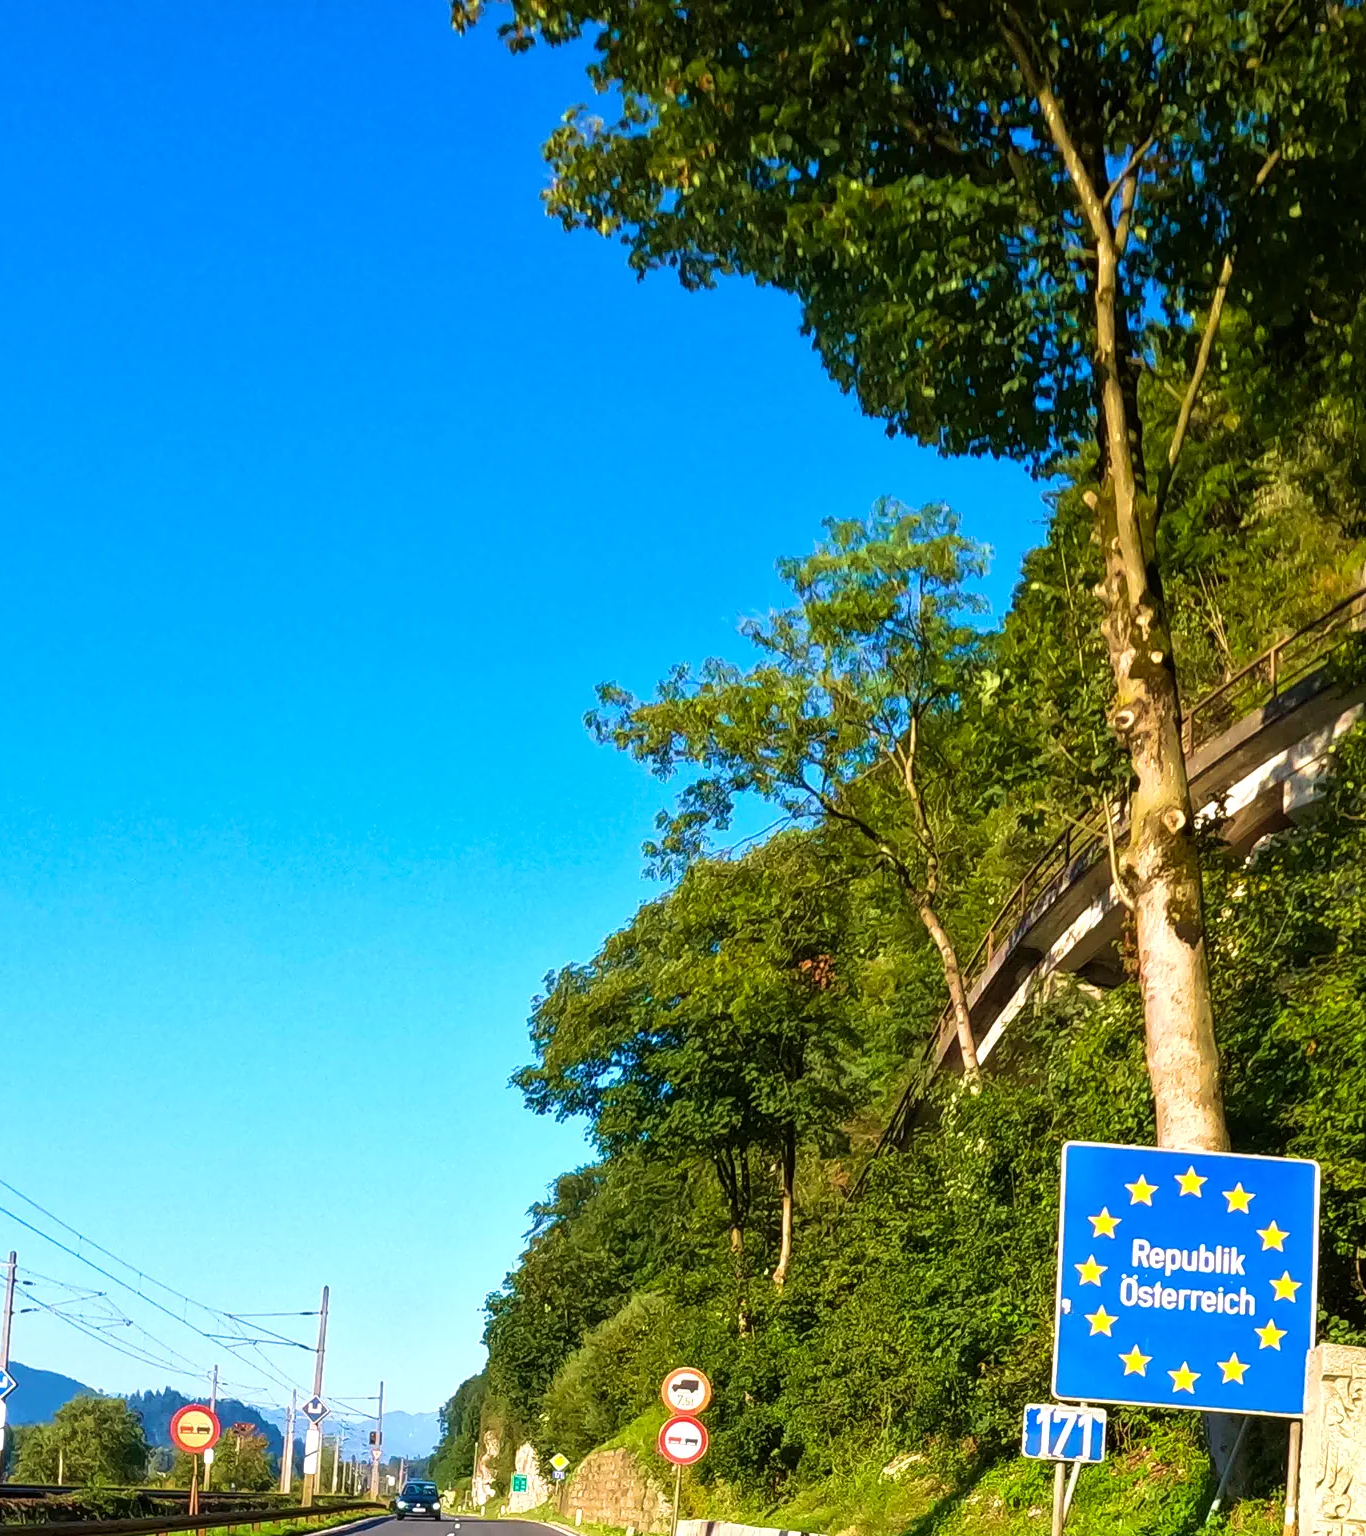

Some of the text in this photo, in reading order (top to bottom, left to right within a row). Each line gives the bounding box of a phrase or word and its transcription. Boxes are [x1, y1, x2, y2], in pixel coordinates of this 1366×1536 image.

[1131, 1238, 1246, 1276] Republik
[1120, 1273, 1256, 1316] Österreich
[1037, 1408, 1094, 1459] 171
